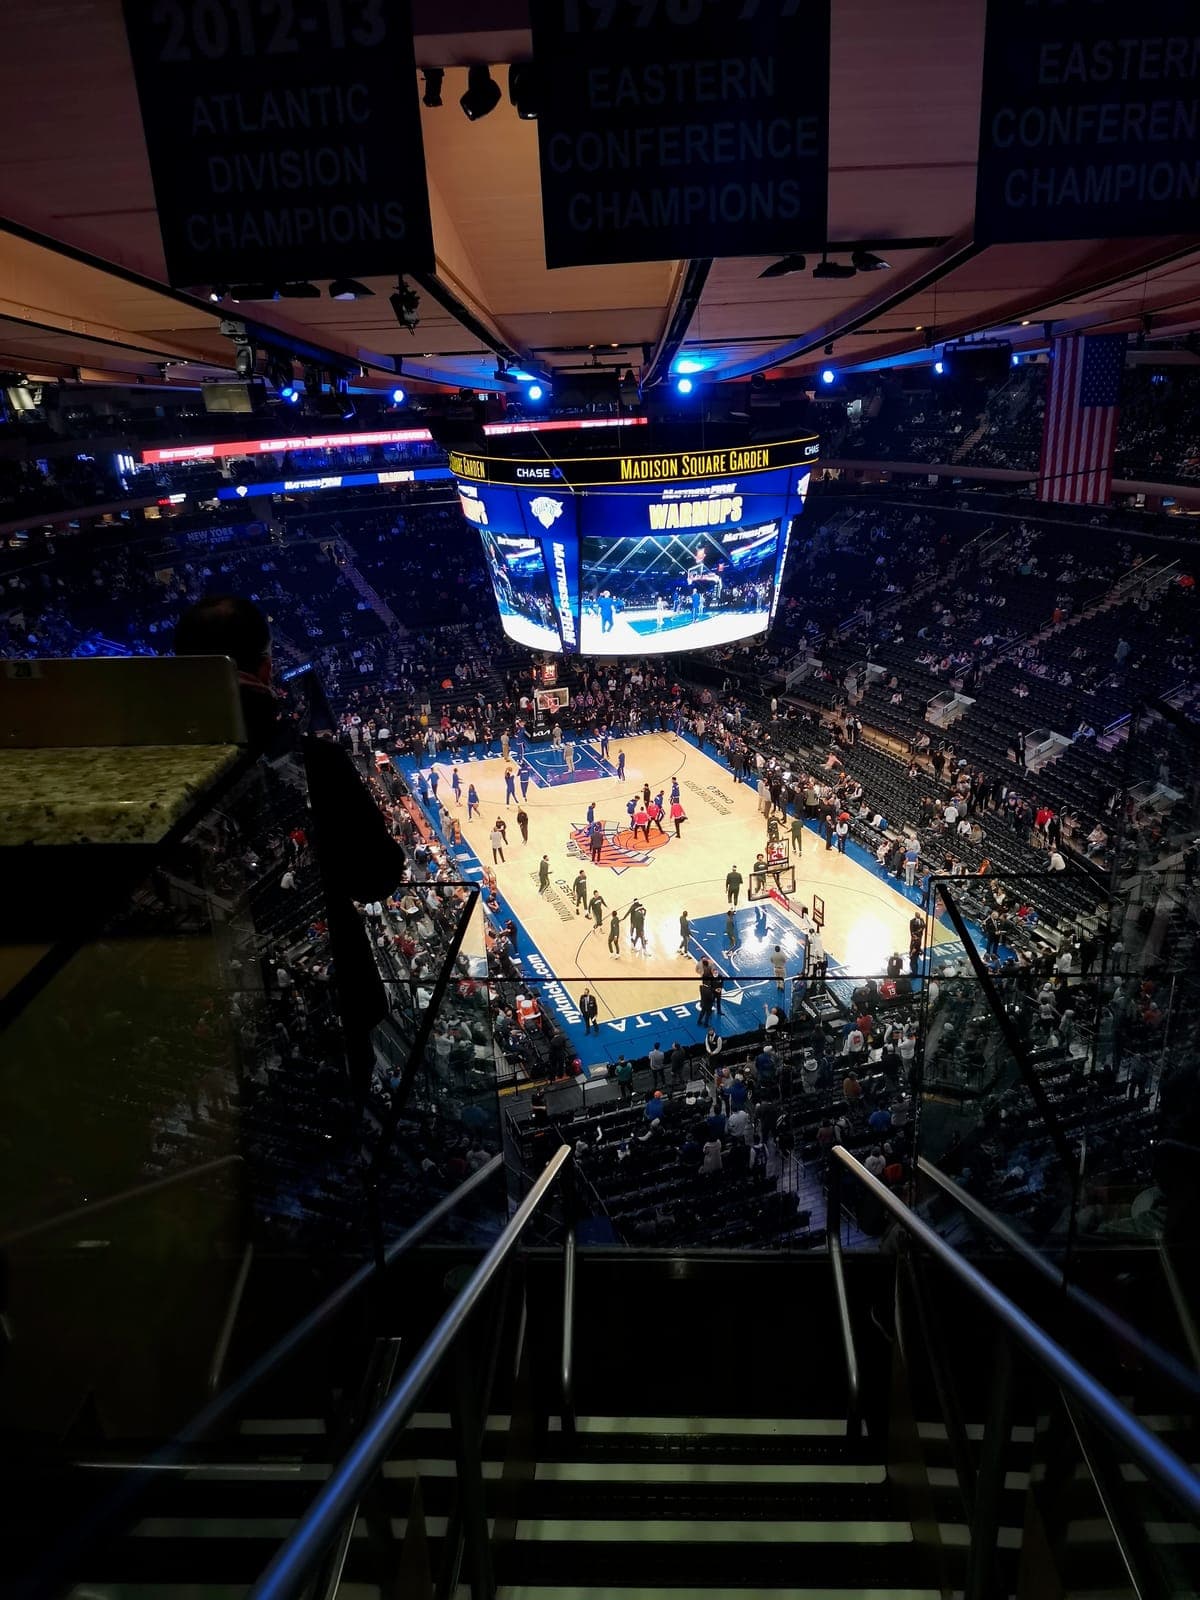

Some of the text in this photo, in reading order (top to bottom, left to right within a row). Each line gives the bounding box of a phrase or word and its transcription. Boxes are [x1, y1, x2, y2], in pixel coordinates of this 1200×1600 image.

[150, 0, 387, 63] 2012-13
[191, 82, 374, 137] ATLANTIC
[586, 56, 778, 111] EASTERN
[207, 145, 369, 194] DIVISION
[547, 115, 820, 174] CONFERENCE
[184, 200, 408, 253] CHAMPIONS
[567, 178, 801, 233] CHAMPIONS
[516, 467, 550, 478] CHASE
[620, 449, 769, 480] MADISON SQUARE GARDEN
[649, 496, 743, 530] WARMUPS
[527, 953, 582, 1024] nyknick.com
